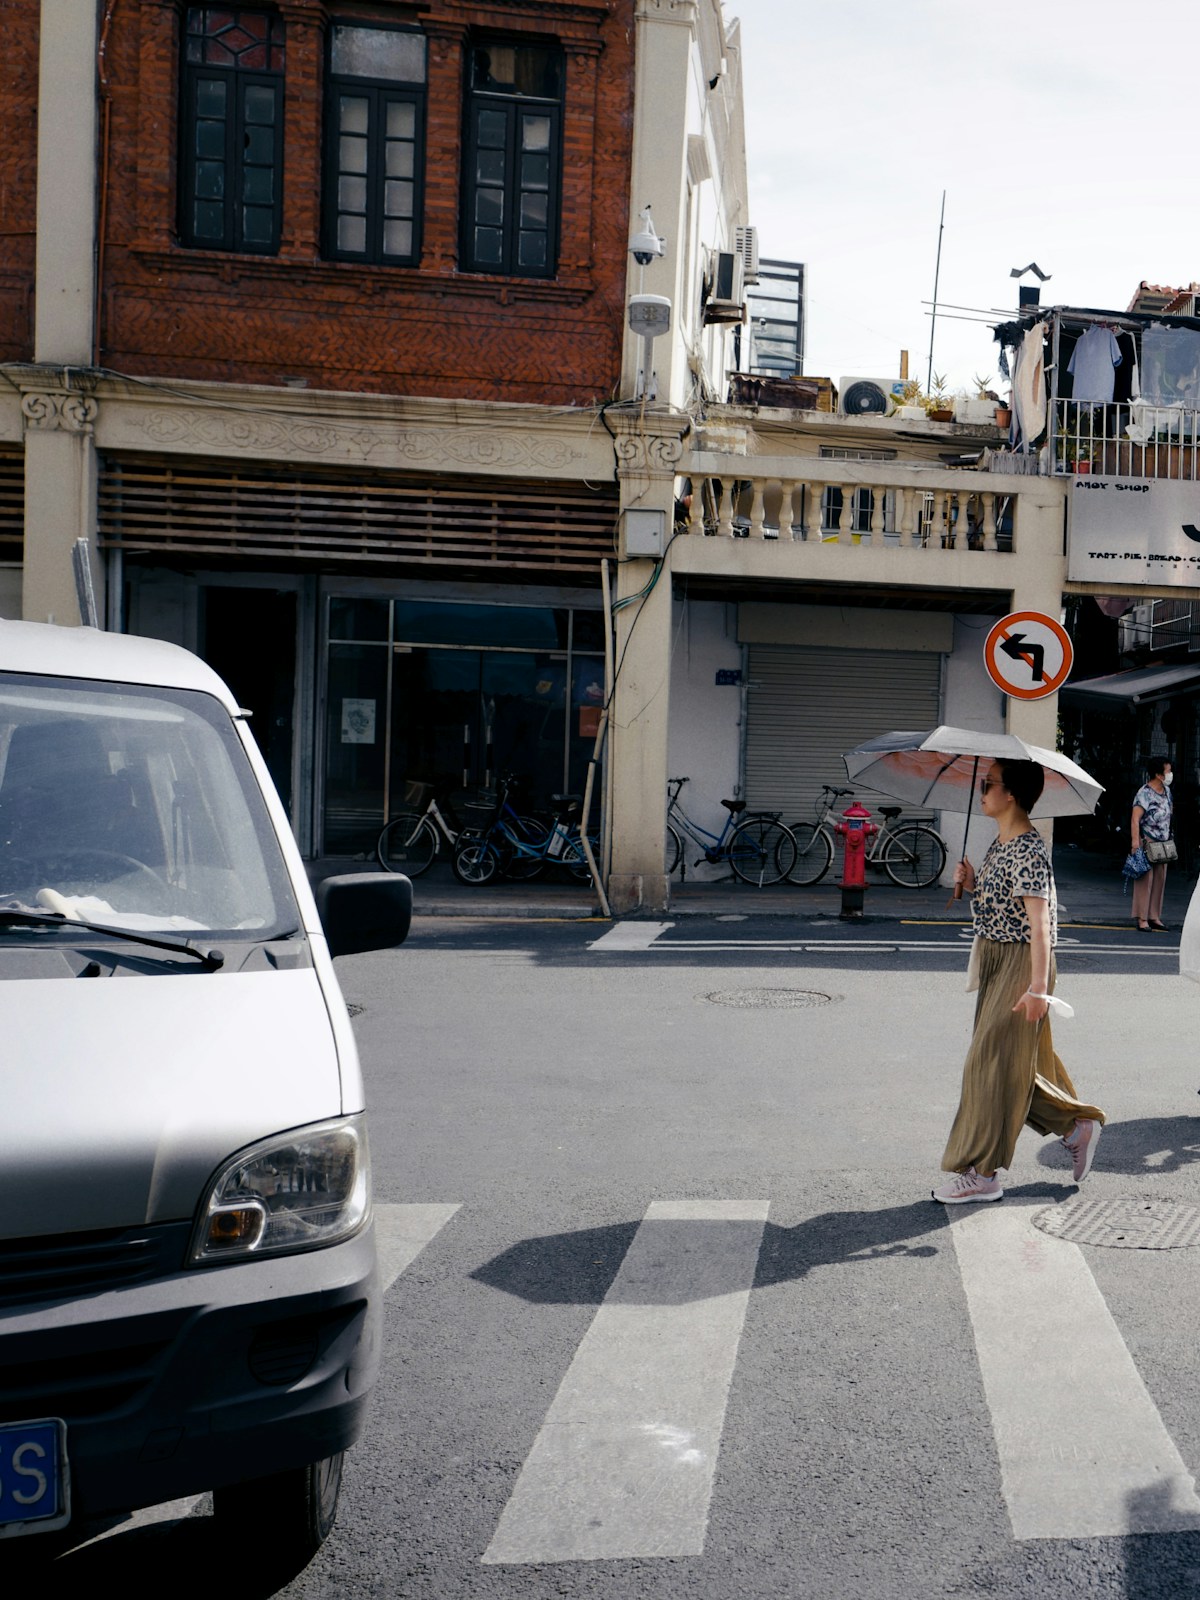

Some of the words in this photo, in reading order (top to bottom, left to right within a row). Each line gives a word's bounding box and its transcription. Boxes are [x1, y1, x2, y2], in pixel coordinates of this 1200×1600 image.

[1076, 481, 1109, 490] AMOY
[1115, 483, 1150, 493] SHOP
[1088, 551, 1118, 560] TART
[1124, 553, 1142, 561] PIE
[1148, 554, 1182, 562] BREAD
[0, 1441, 47, 1504] S
